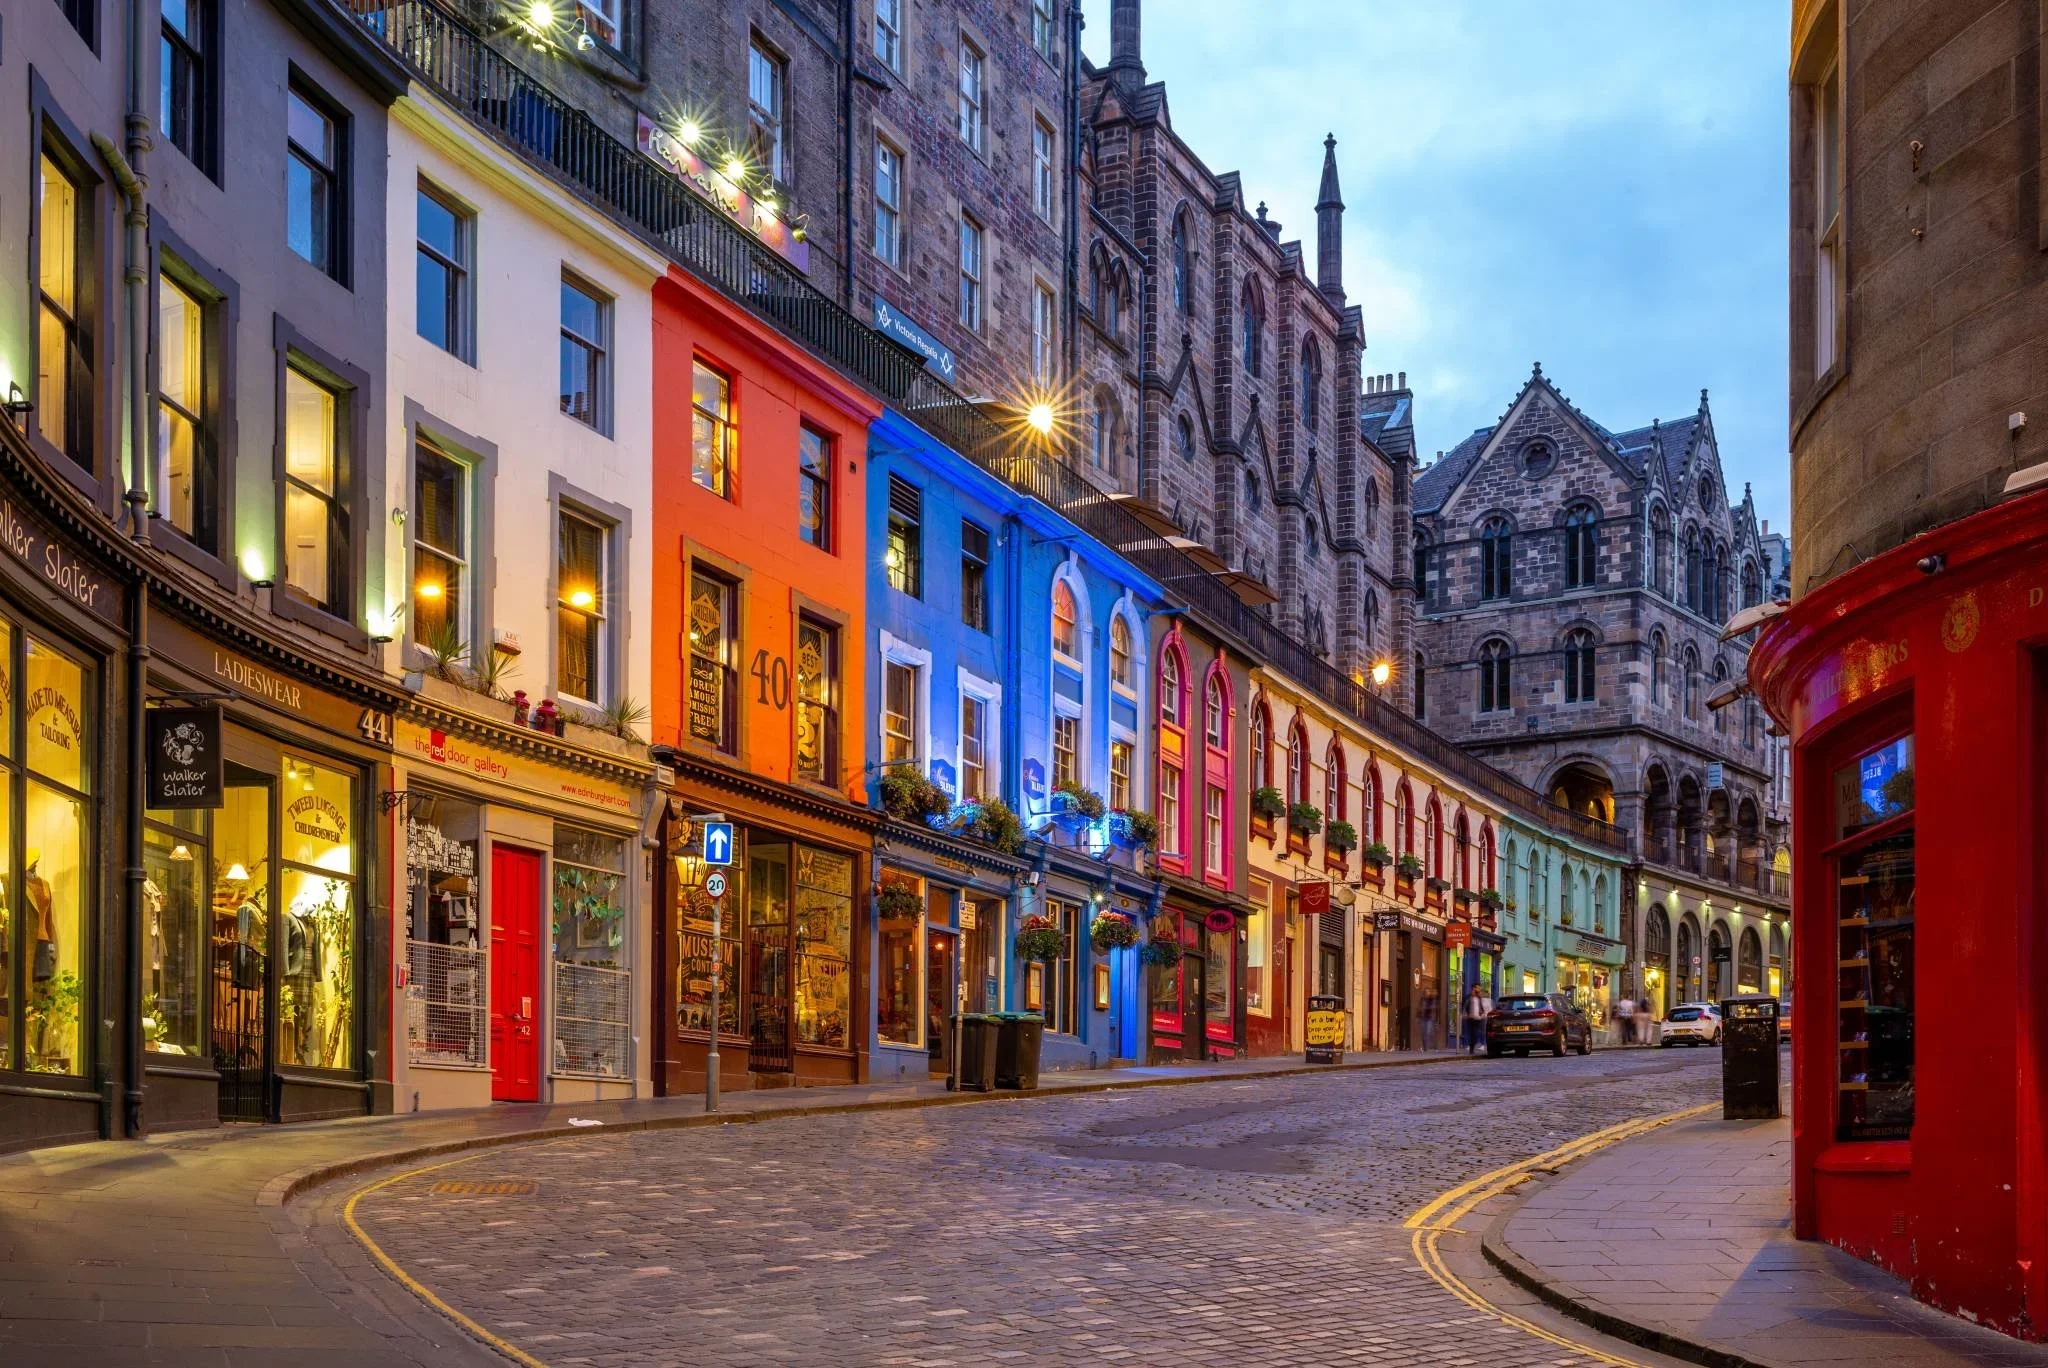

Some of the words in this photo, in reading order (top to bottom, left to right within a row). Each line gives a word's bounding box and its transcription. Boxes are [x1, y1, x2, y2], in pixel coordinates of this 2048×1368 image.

[894, 318, 917, 344] Victoria
[917, 336, 938, 360] Regalia
[0, 500, 34, 560] lker
[45, 544, 99, 607] Slater
[802, 651, 818, 668] BEST
[215, 652, 301, 709] LADIESWEAR
[690, 677, 715, 694] ORLD
[751, 648, 789, 711] 40
[43, 687, 54, 706] TO
[690, 688, 716, 705] AMOUS
[690, 699, 718, 716] MISSIO
[40, 722, 70, 750] TAILORING
[415, 735, 430, 754] the
[431, 742, 445, 758] red
[447, 745, 470, 764] door
[473, 755, 508, 779] gallery
[163, 783, 206, 797] Slater
[560, 783, 631, 808] www.edinburghart.com
[287, 795, 314, 821] TWEED
[316, 795, 347, 835] LUGGAGE
[294, 821, 341, 844] CHILDRENSWEAR
[708, 879, 725, 892] 20
[1426, 924, 1438, 936] SHOP
[691, 957, 723, 976] CONTT
[521, 1025, 531, 1036] 42
